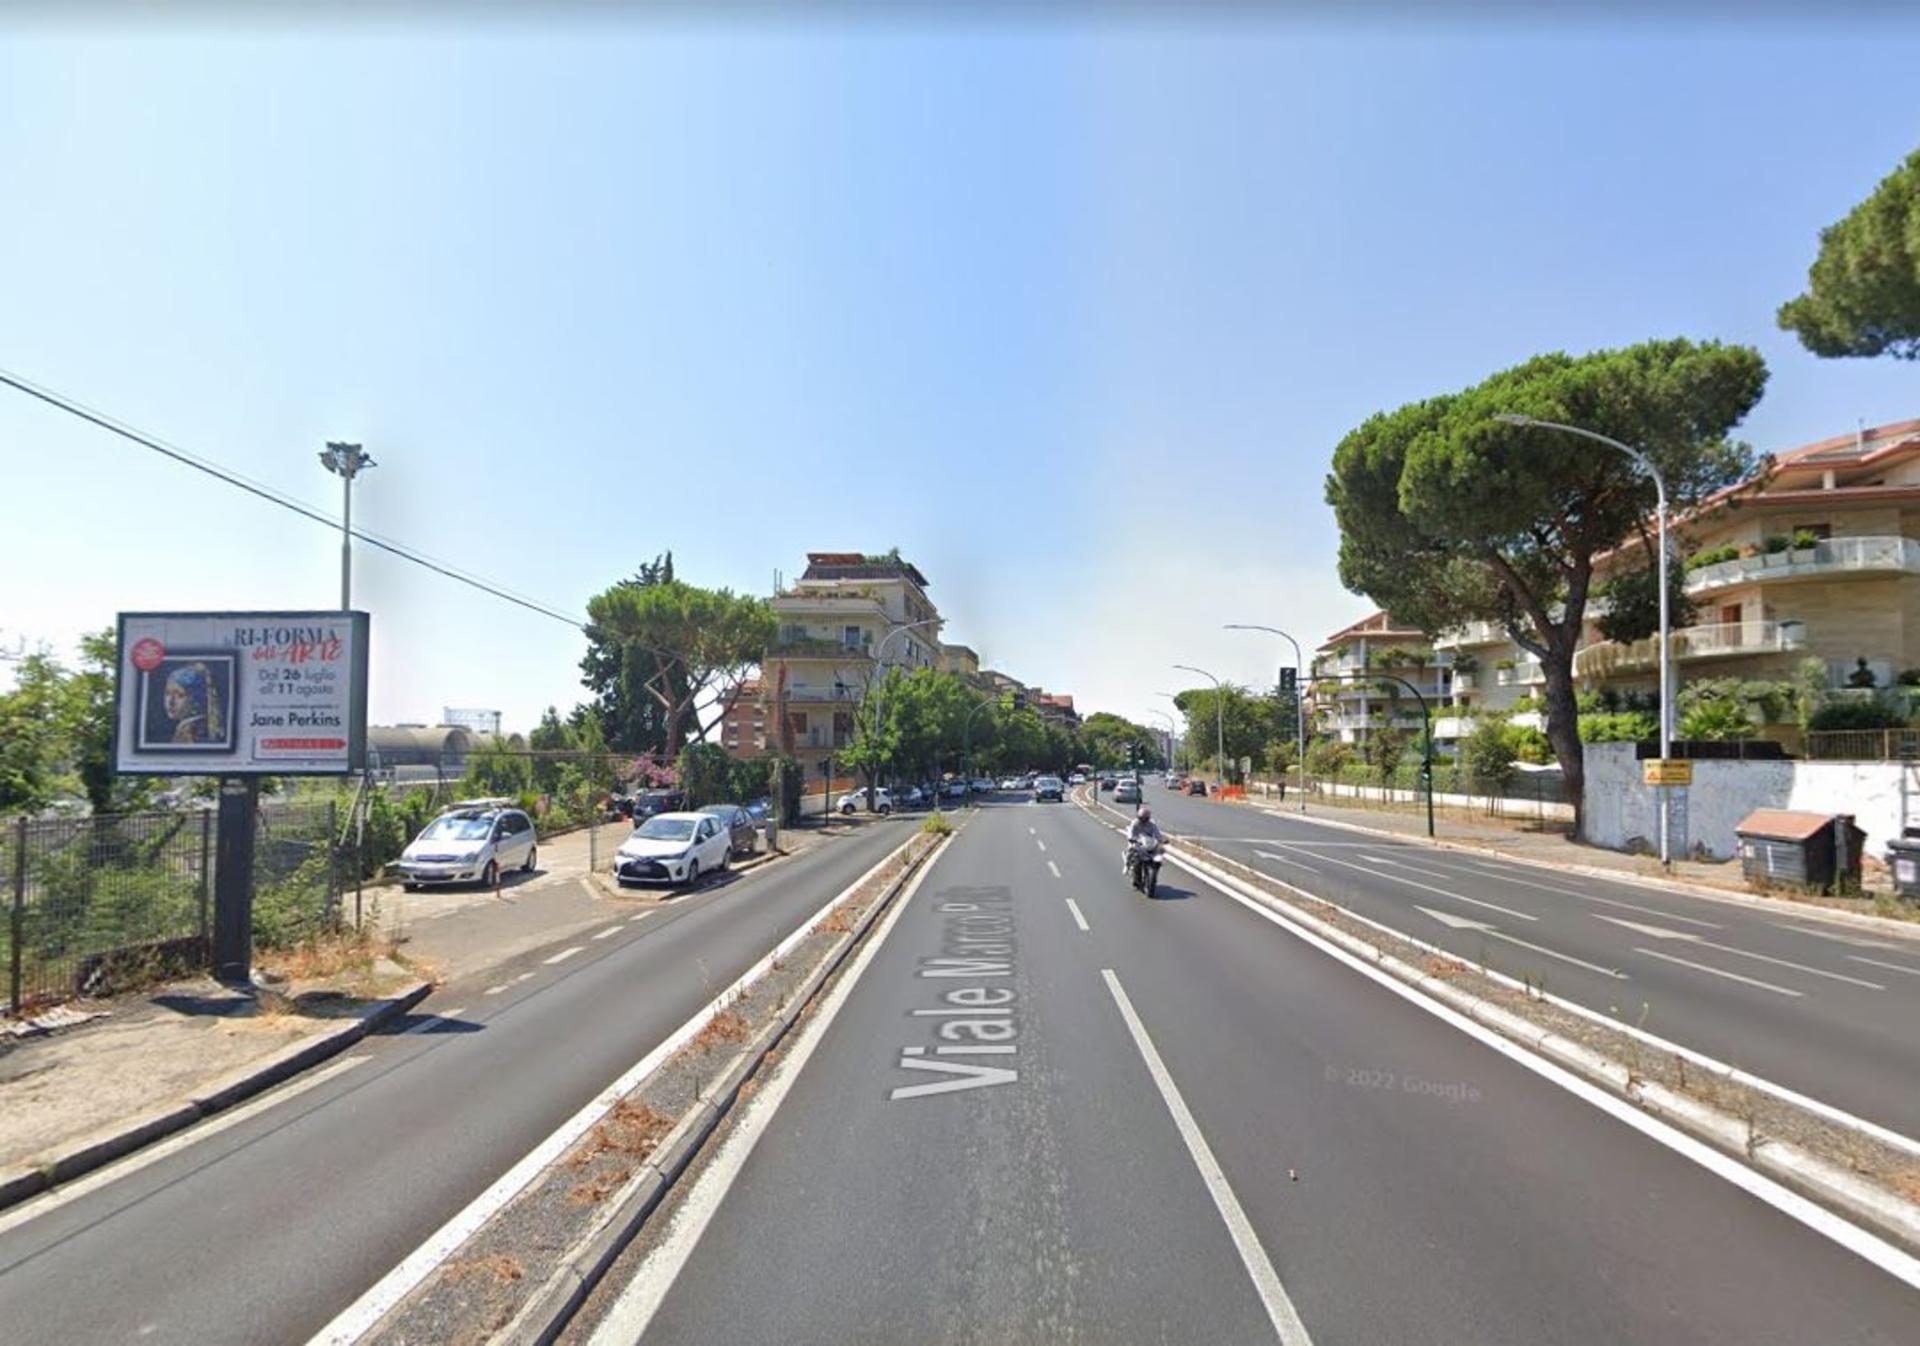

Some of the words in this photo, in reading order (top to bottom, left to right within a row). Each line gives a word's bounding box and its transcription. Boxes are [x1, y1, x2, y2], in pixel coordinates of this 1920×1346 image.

[258, 669, 279, 681] Dal
[283, 668, 301, 680] 26
[304, 668, 336, 683] luglio
[250, 712, 284, 726] Jane
[289, 711, 341, 726] Perkins
